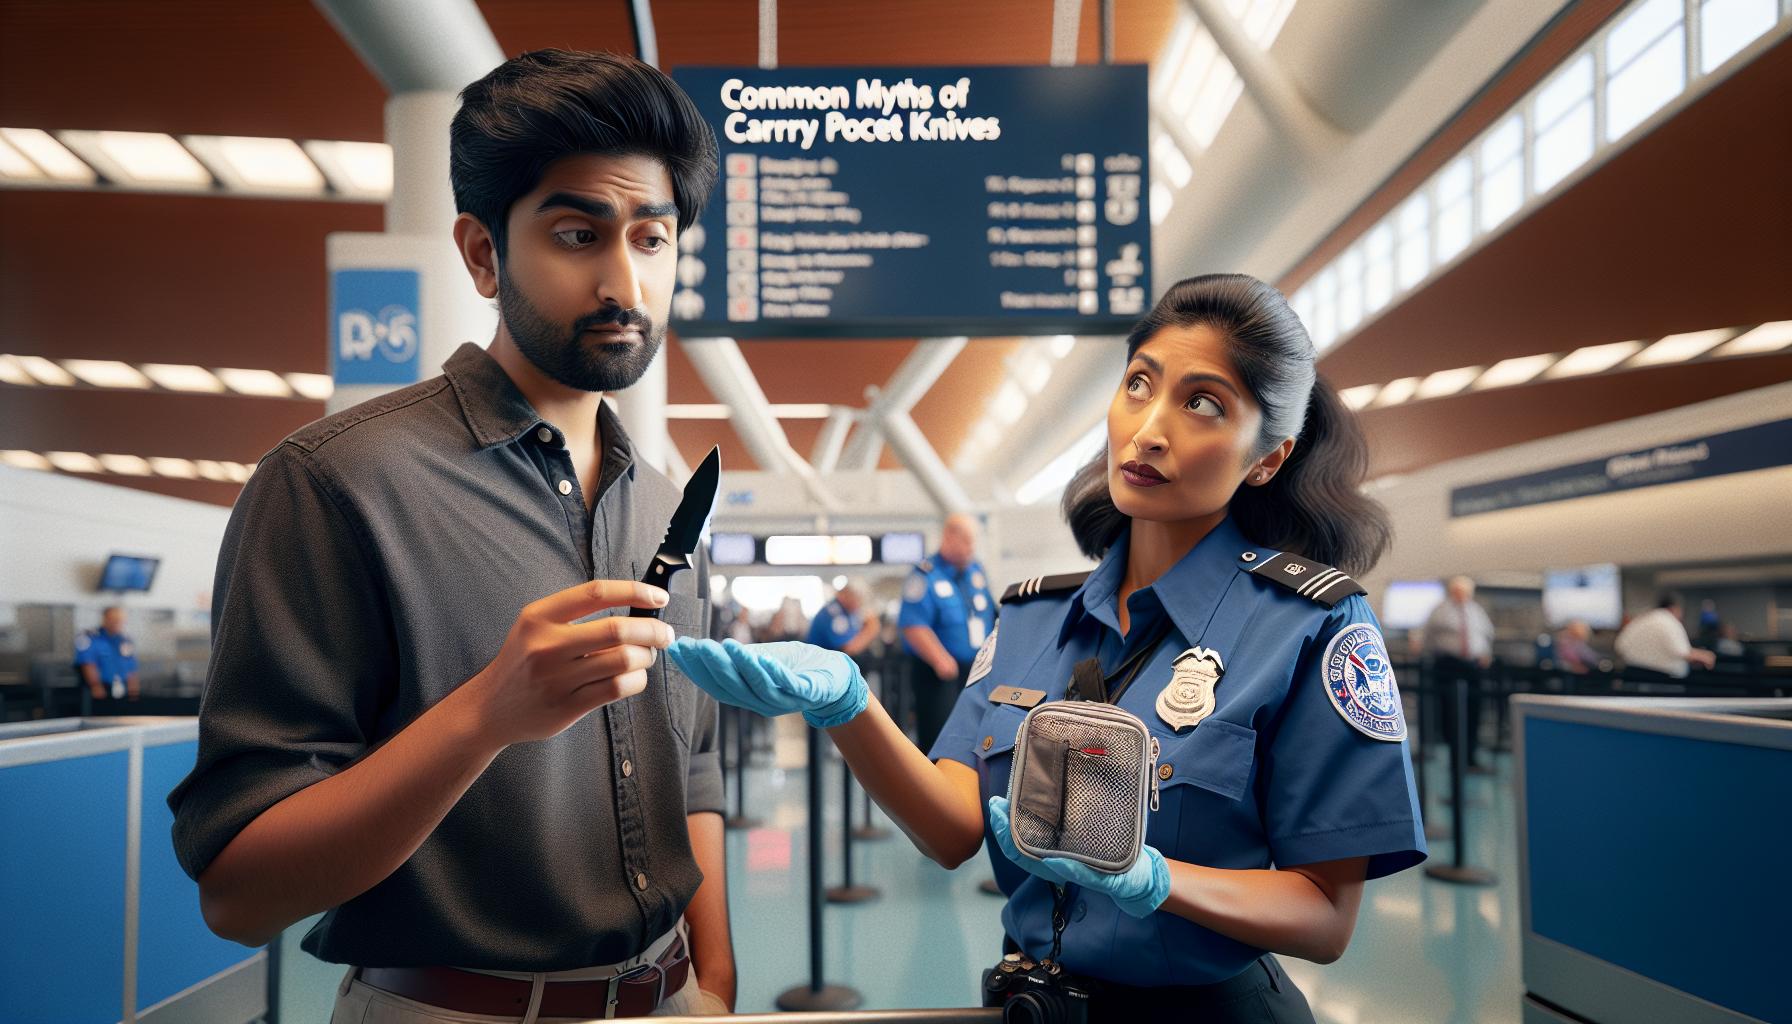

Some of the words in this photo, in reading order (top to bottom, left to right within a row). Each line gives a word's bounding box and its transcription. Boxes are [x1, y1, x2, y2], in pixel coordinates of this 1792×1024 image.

[720, 78, 850, 110] Common
[856, 78, 934, 116] Myths
[938, 77, 971, 109] of
[909, 110, 1001, 141] Knives
